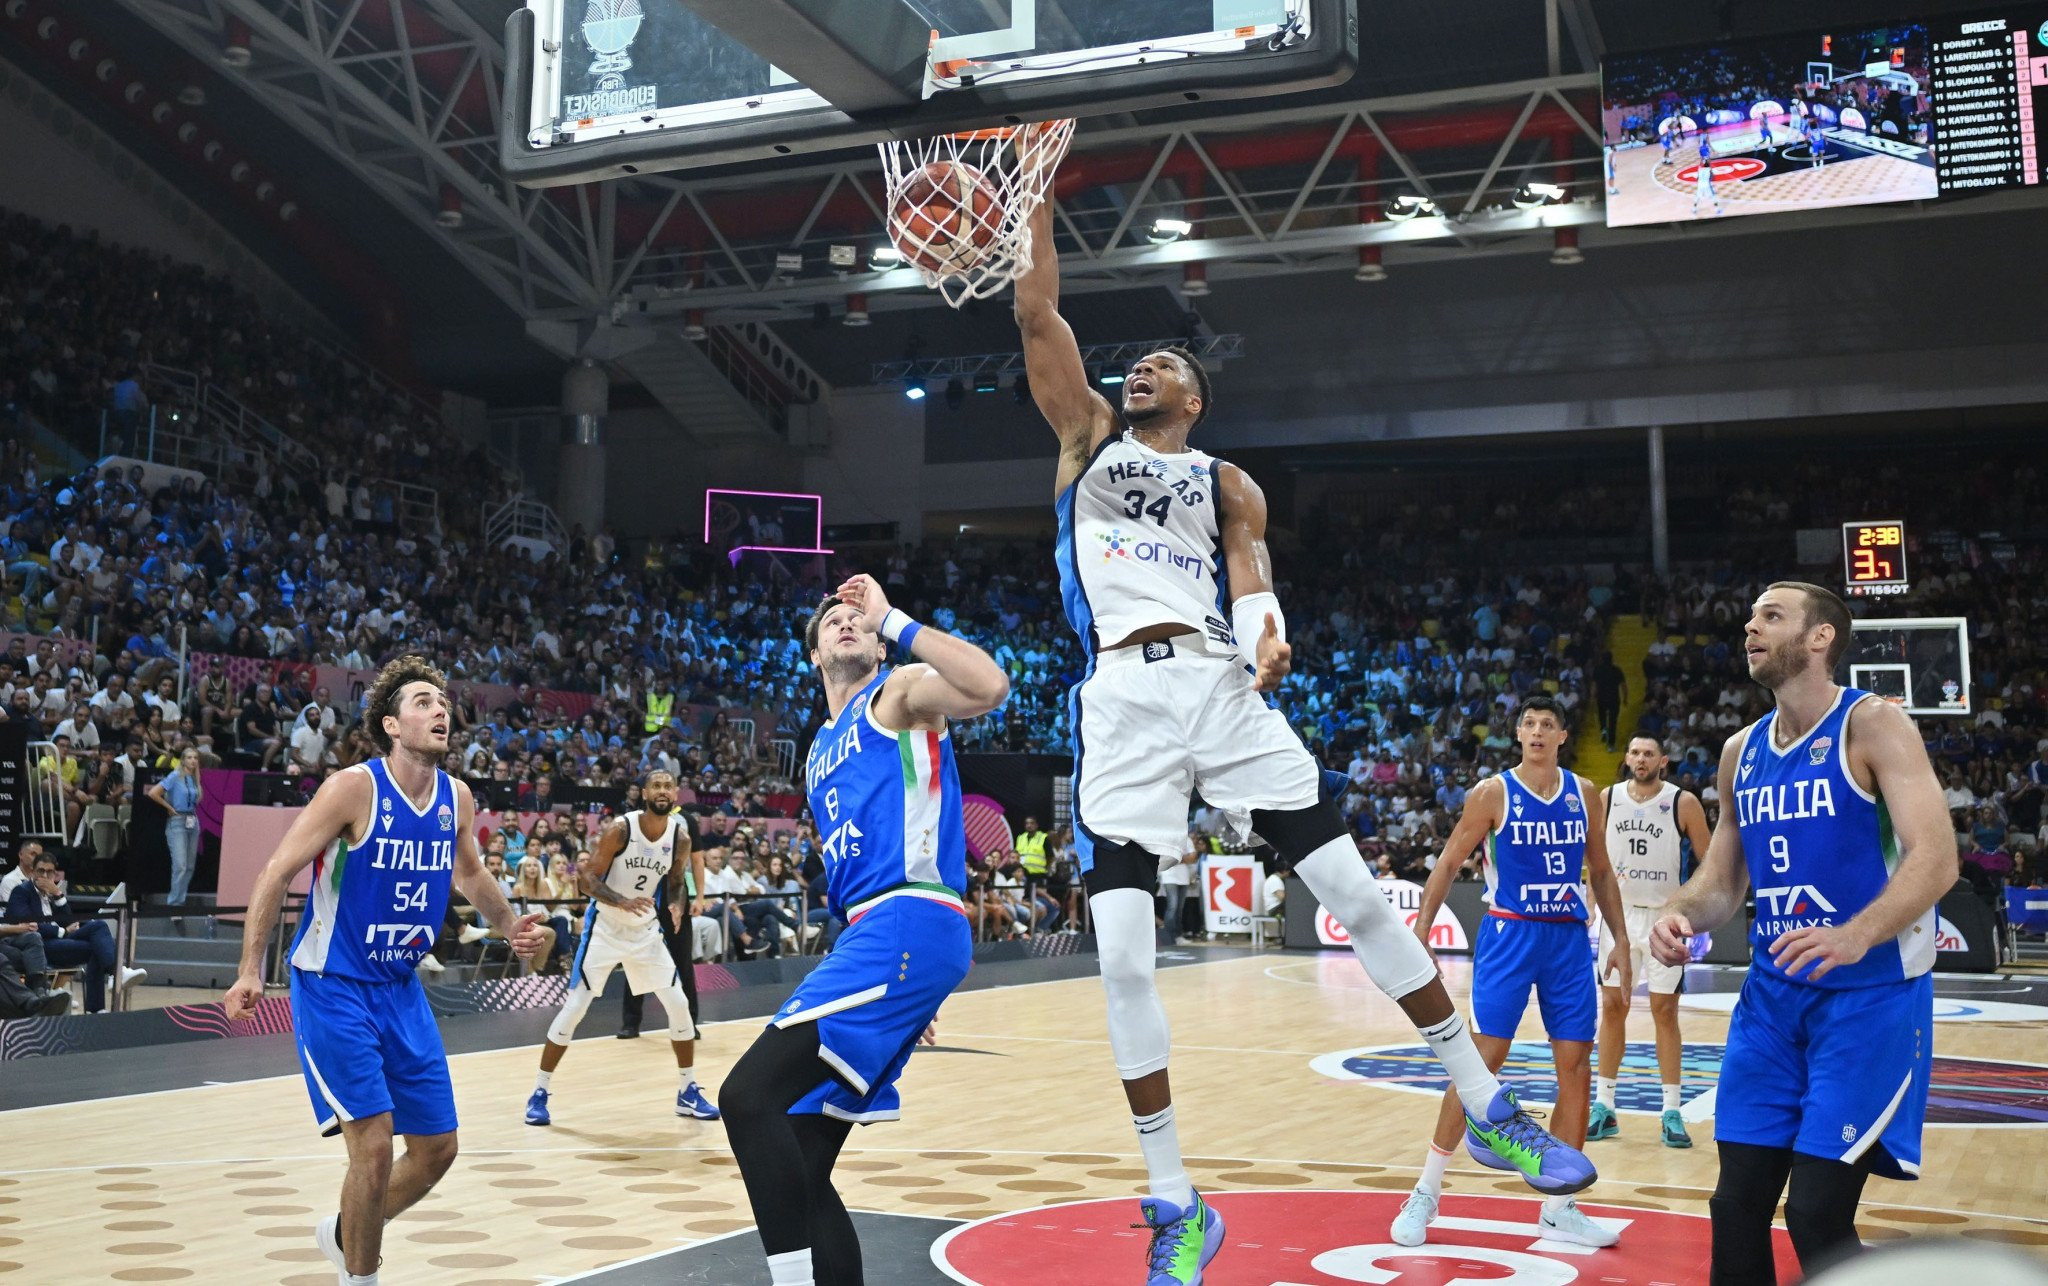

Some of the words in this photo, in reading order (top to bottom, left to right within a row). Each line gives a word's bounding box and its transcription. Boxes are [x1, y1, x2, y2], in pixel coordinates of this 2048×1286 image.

[1961, 20, 2006, 34] GREECE
[1943, 39, 1977, 50] DORSEY
[1944, 50, 1994, 62] LARENTZAKIS
[1944, 62, 1996, 74] TOLIOPOULOS
[1946, 78, 1985, 88] SLOUKAS
[1936, 93, 1944, 101] 11
[1946, 87, 1998, 100] KALAITZAKIS
[1947, 100, 1998, 112] PAPANIKOLAOU
[1948, 112, 1995, 126] KATSIVELIS
[1953, 177, 1996, 188] MITOGLOU
[1108, 461, 1204, 506] HELLAS
[1124, 490, 1172, 526] 34
[1859, 527, 1900, 546] 2:38
[1854, 550, 1891, 579] 3.7
[1863, 584, 1909, 595] TISSOT
[808, 723, 862, 794] TALIA
[825, 786, 838, 822] 8
[1736, 778, 1836, 828] ITALIA
[1510, 820, 1586, 845] ITALIA
[1616, 819, 1664, 839] HELLAS
[372, 838, 452, 870] ITALIA
[1629, 838, 1648, 856] 16
[1770, 836, 1790, 873] 9
[625, 856, 666, 876] HELLAS
[1543, 852, 1566, 876] 13
[634, 874, 648, 891] 2
[1520, 882, 1581, 902] ITA
[393, 882, 428, 912] 54
[1756, 885, 1838, 916] TA
[1525, 903, 1578, 913] AIRWAY
[1219, 916, 1250, 926] EKO
[365, 924, 435, 946] ITA
[1935, 930, 1960, 949] en
[368, 948, 426, 962] AIRWAY
